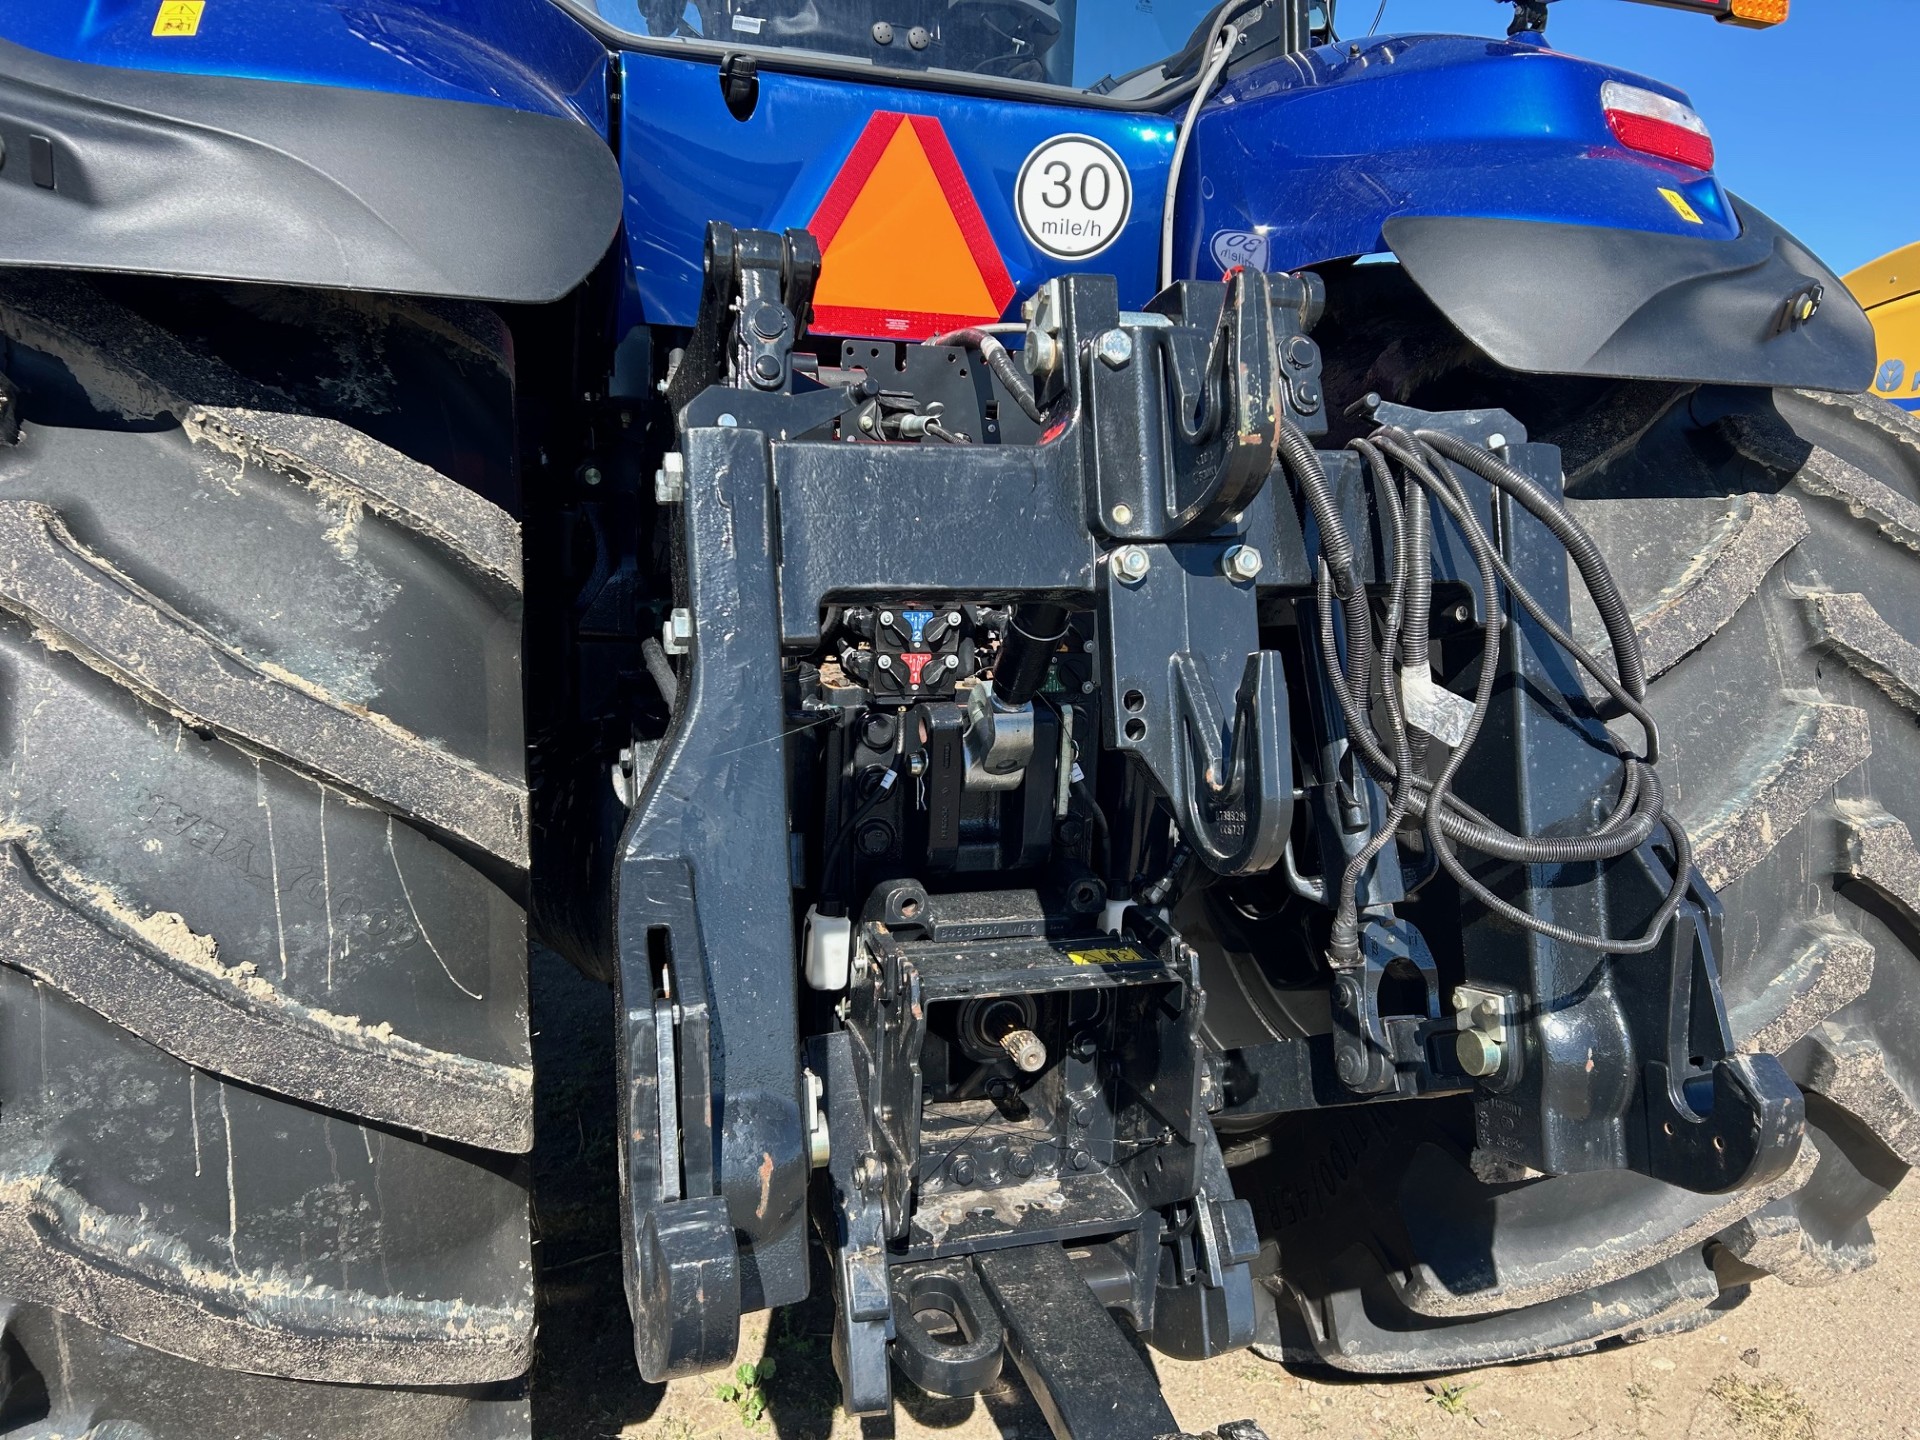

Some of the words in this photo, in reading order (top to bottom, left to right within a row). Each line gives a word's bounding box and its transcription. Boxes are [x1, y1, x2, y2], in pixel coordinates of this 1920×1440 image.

[1041, 160, 1111, 211] 30
[1041, 218, 1102, 237] mile/h
[913, 631, 921, 640] 2
[912, 672, 918, 681] 1
